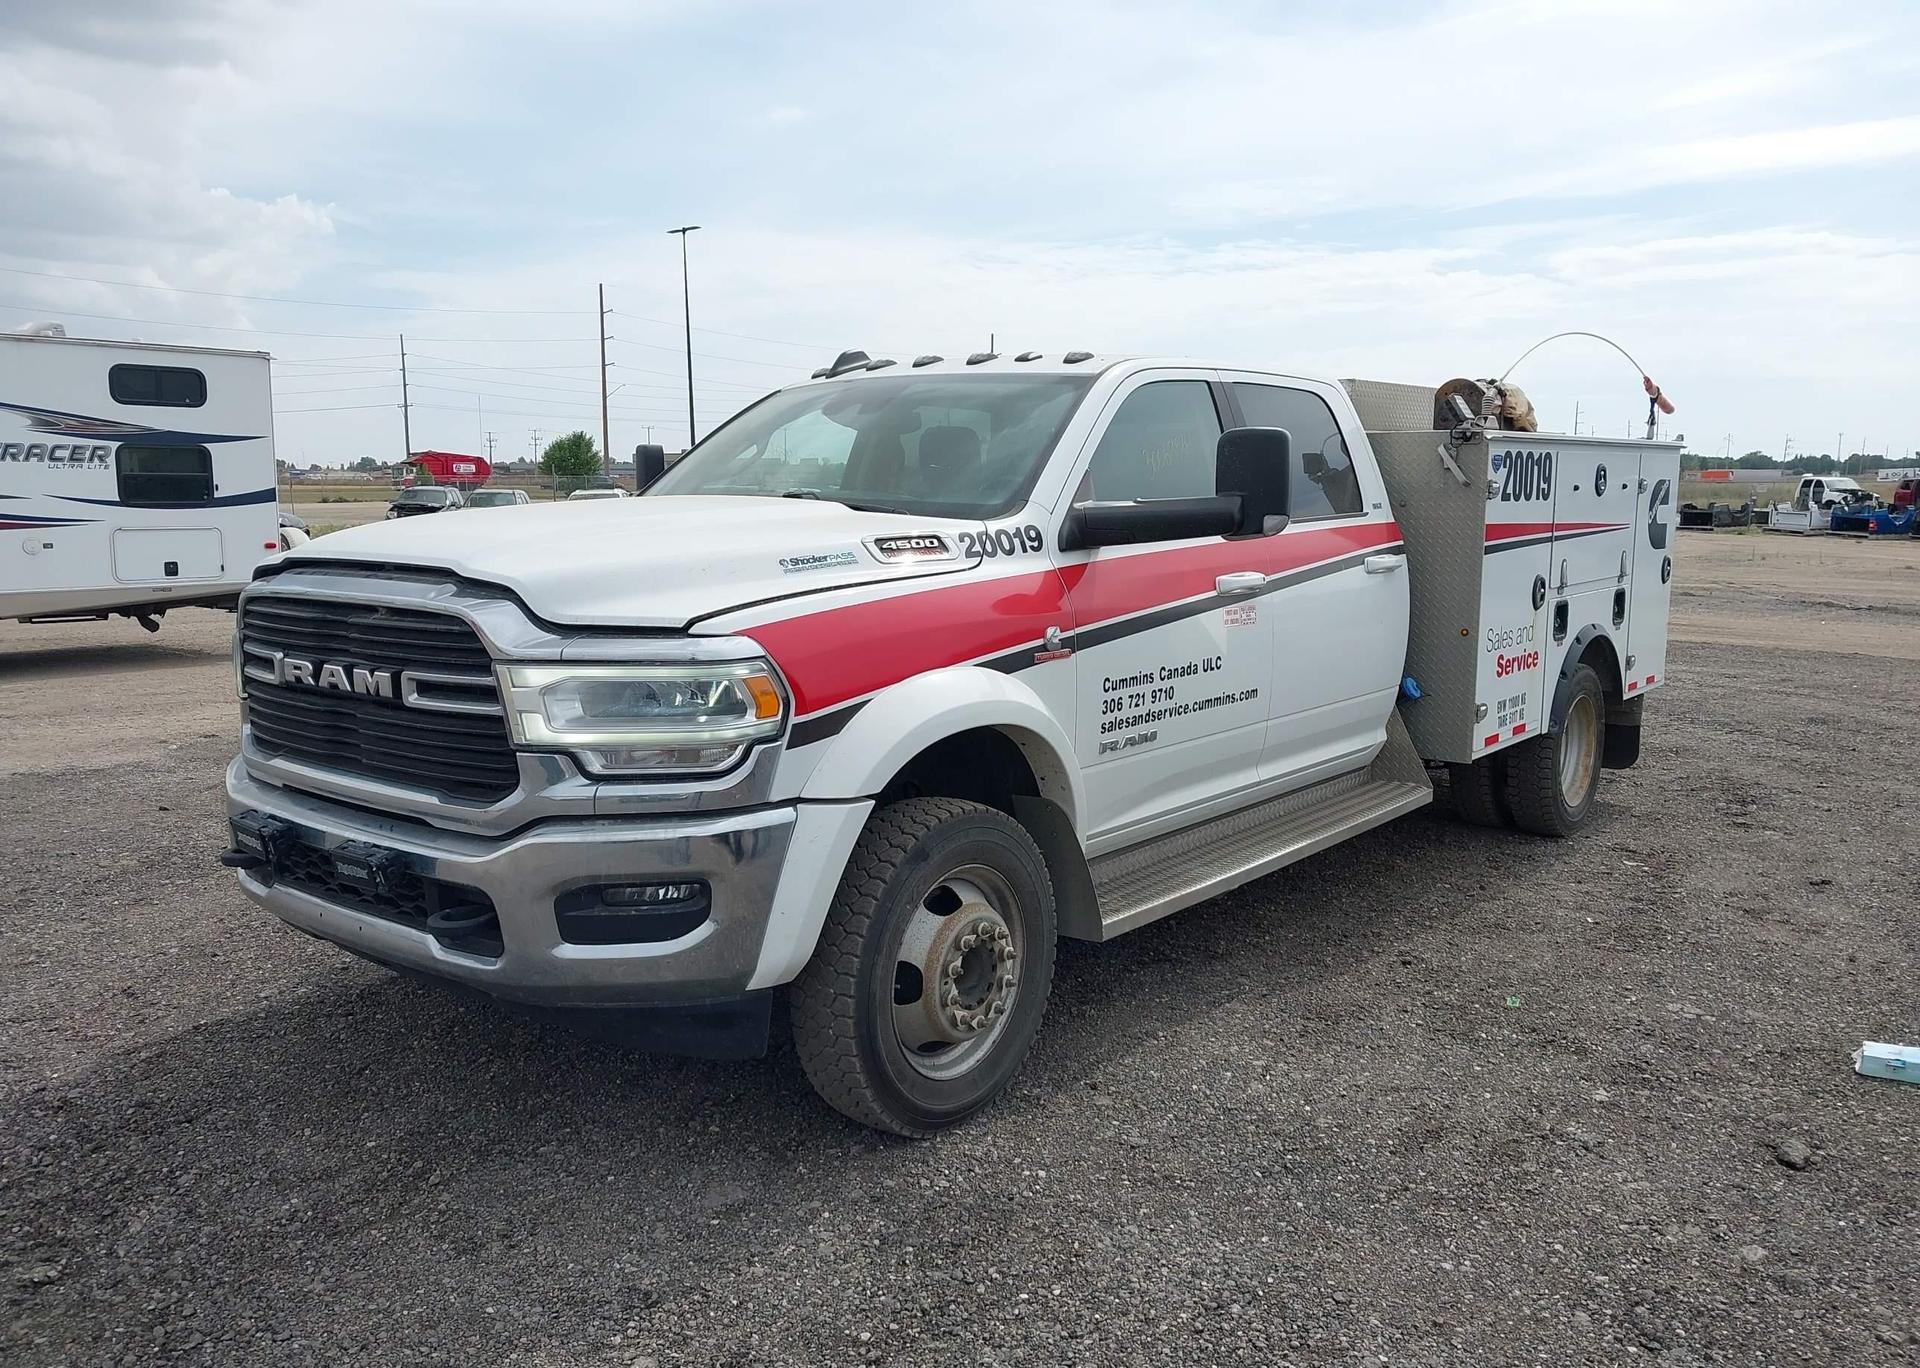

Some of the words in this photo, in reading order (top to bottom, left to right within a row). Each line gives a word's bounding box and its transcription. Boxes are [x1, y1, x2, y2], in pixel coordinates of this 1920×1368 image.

[0, 442, 112, 464] RACER
[1501, 450, 1552, 502] 20019
[881, 537, 939, 550] 4500
[959, 524, 1044, 559] 20019
[1486, 628, 1514, 653] Sales
[1516, 622, 1534, 643] and
[284, 658, 393, 698] RAM
[1102, 671, 1155, 693] Cummins
[1159, 661, 1199, 681] Canada
[1202, 655, 1222, 673] ULC
[1496, 649, 1539, 678] Service
[1100, 687, 1258, 734] salesandservice.cummins.com
[1101, 696, 1123, 715] 306
[1127, 692, 1147, 709] 721
[1151, 685, 1175, 704] 9710
[1497, 713, 1508, 729] TARE
[1098, 729, 1158, 755] RAM
